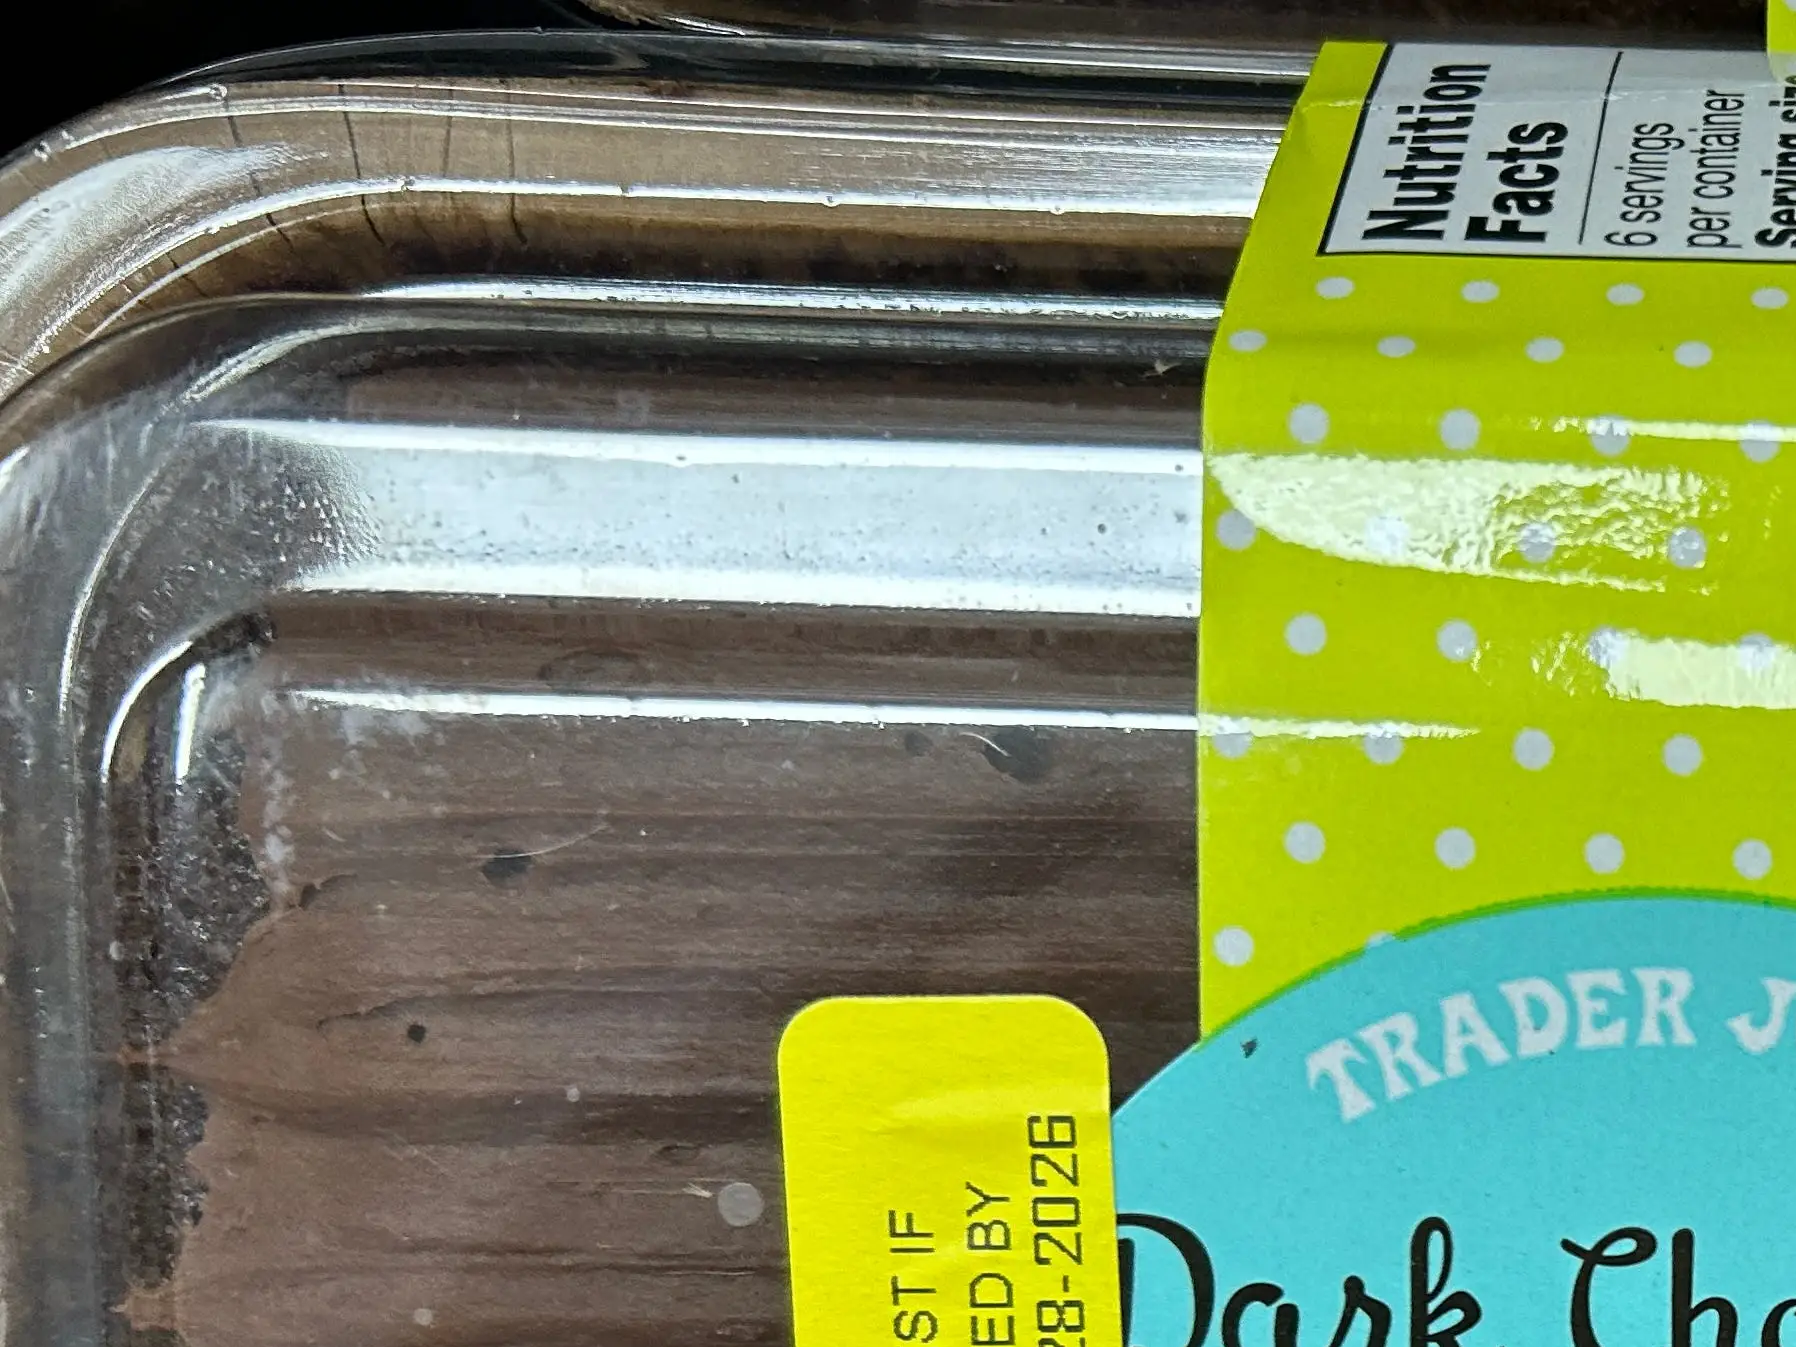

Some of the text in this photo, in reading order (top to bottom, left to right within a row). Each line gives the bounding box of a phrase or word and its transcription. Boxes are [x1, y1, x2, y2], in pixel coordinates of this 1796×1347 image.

[1361, 64, 1491, 240] Nutrition
[1465, 121, 1568, 243] Facts
[1605, 122, 1685, 246] 6 servings
[1687, 89, 1745, 249] per container
[1306, 967, 1698, 1124] TRADER
[889, 1210, 936, 1253] IF
[966, 1182, 1011, 1251] BY
